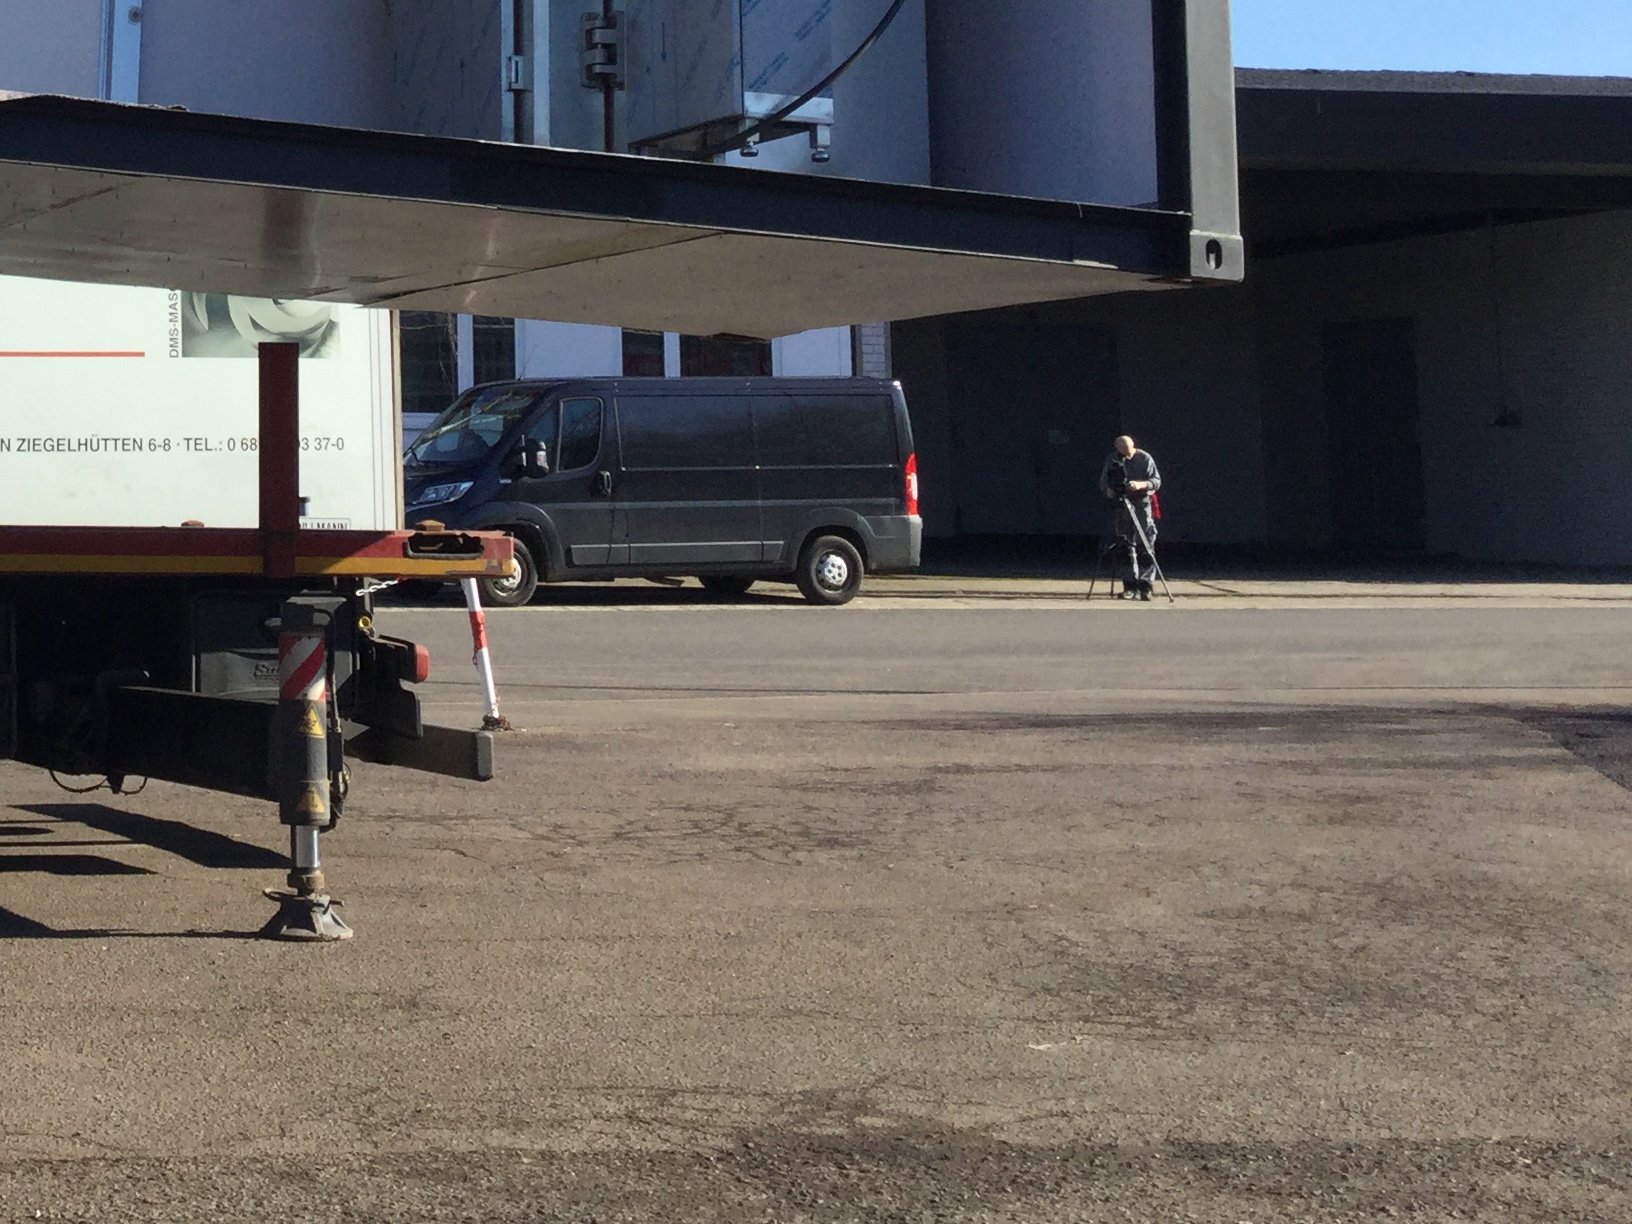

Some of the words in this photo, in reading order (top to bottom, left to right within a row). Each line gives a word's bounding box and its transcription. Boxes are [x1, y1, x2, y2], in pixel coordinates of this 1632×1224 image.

[16, 433, 143, 453] ZIEGELHÜTTEN
[148, 437, 172, 452] 6-8
[183, 437, 223, 452] TEL.:
[314, 437, 345, 451] 37-0
